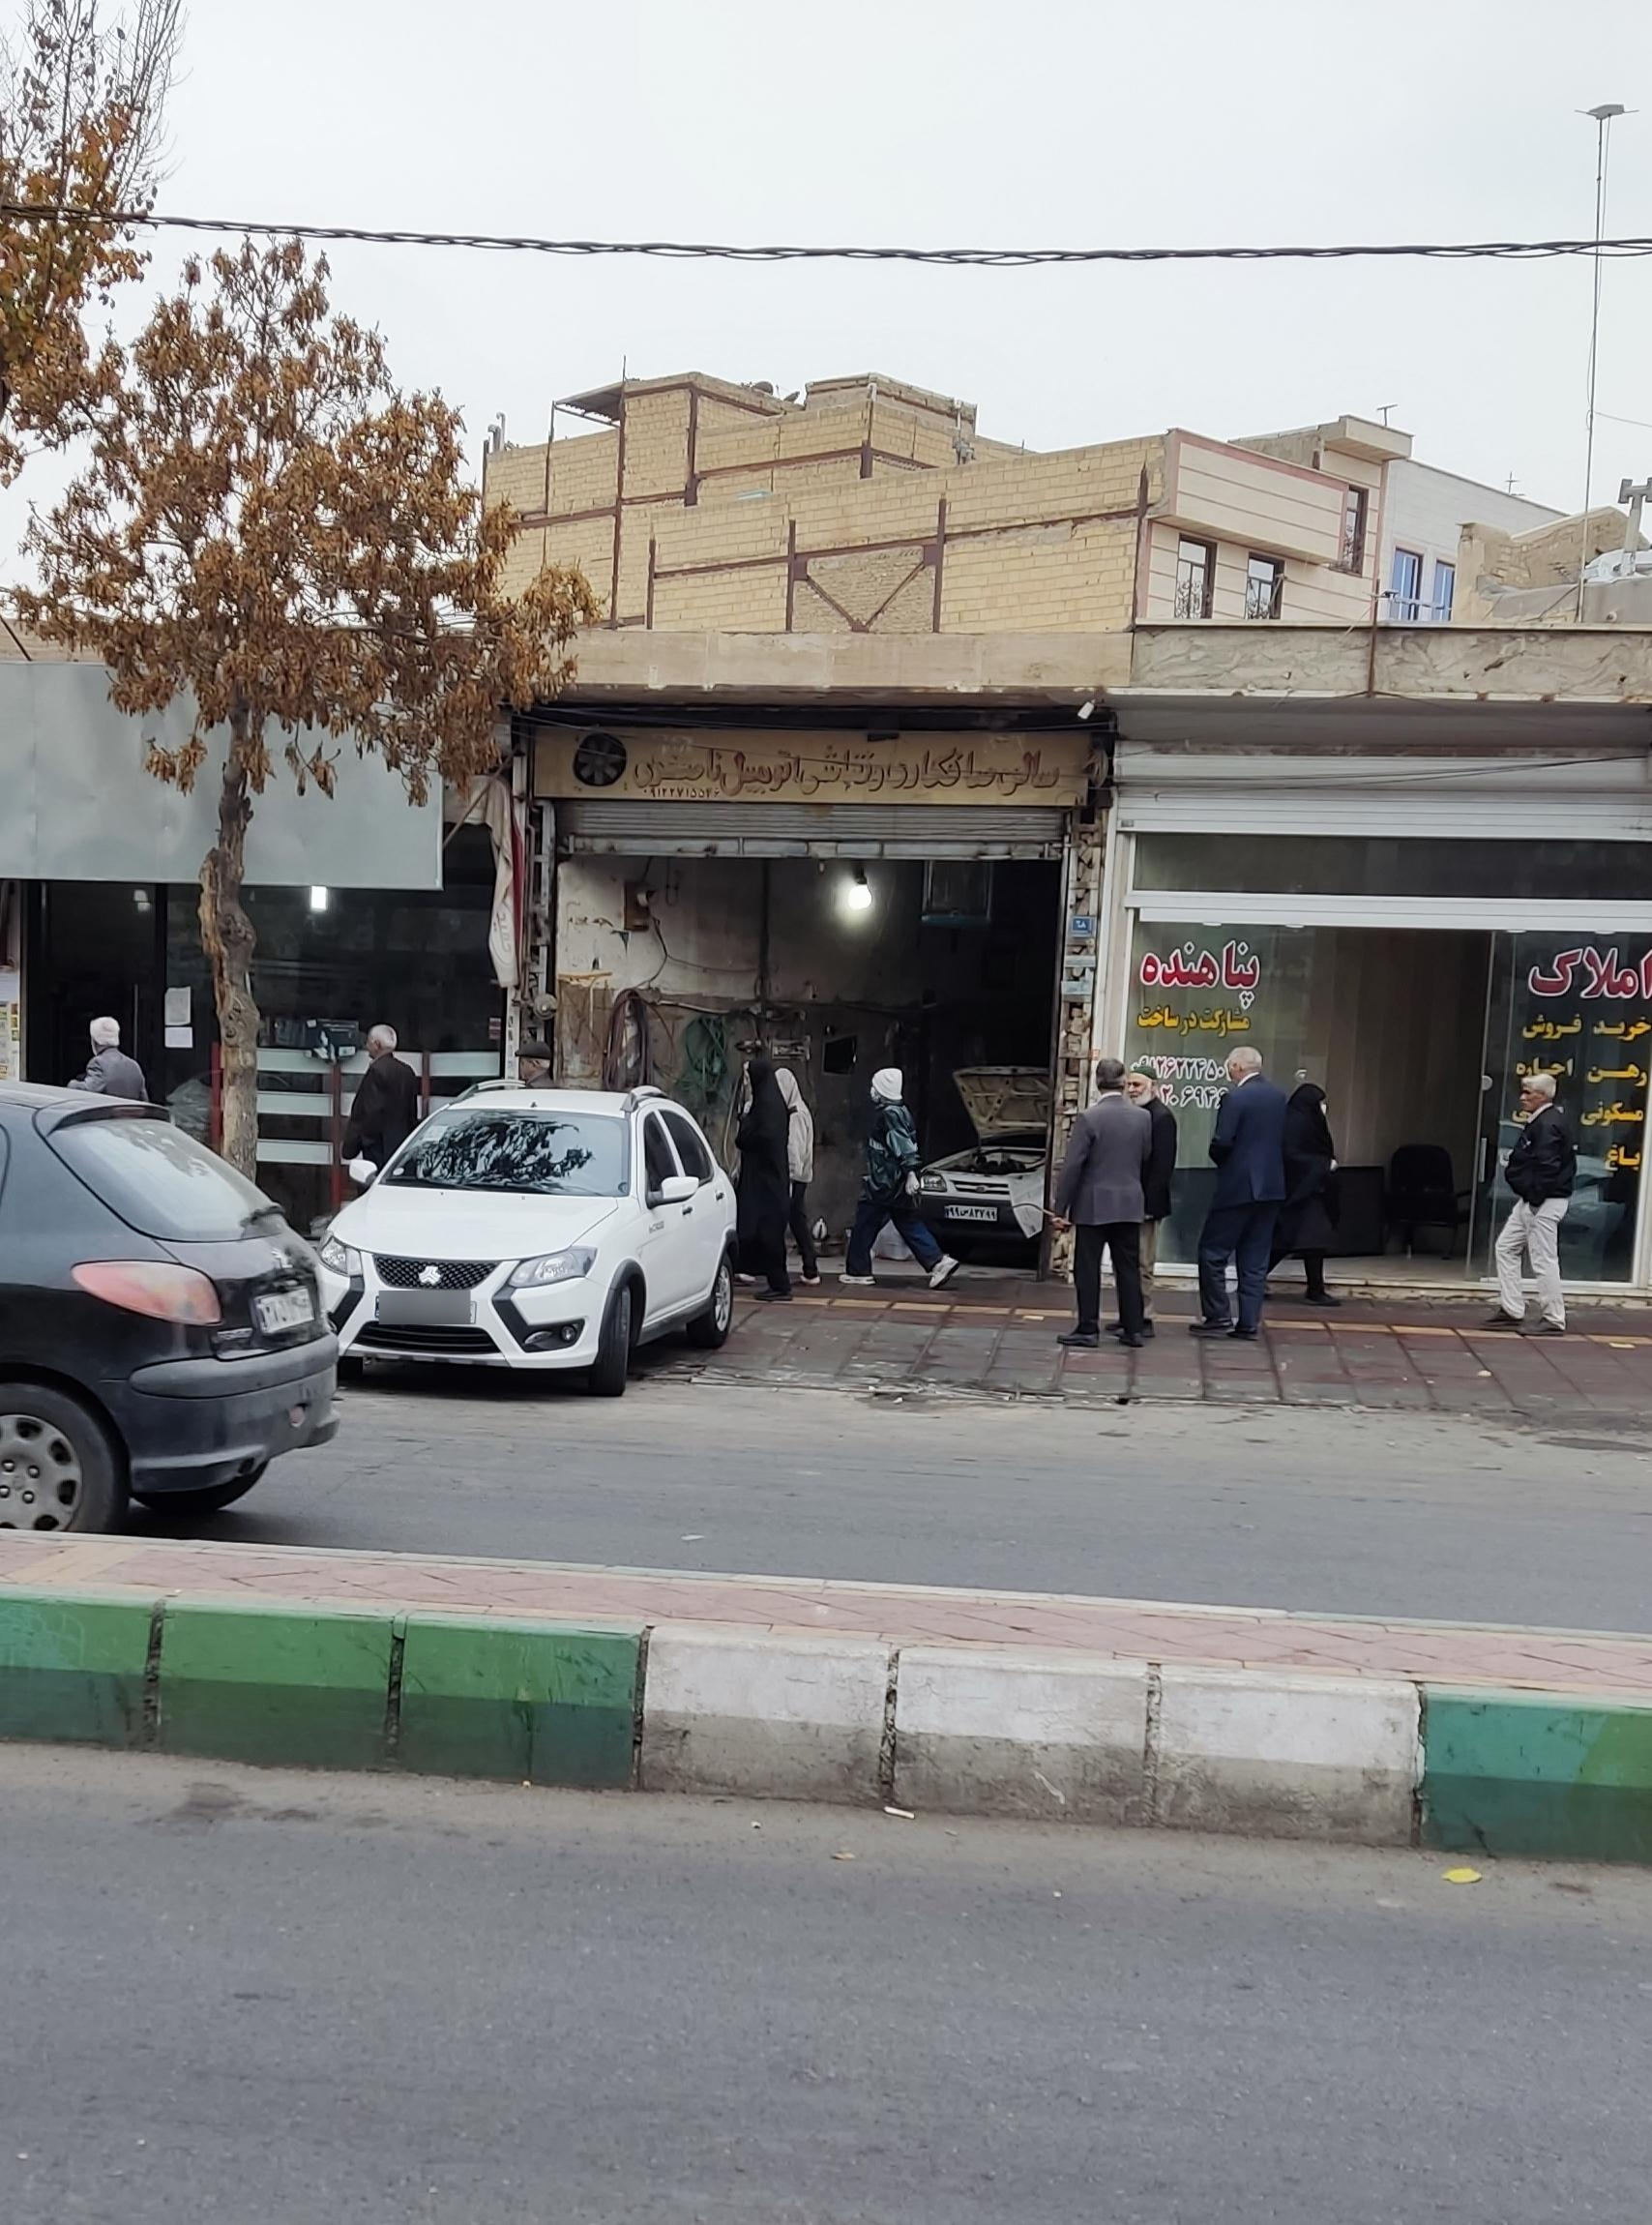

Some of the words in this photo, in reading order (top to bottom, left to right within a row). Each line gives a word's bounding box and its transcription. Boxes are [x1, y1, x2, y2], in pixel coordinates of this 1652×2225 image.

[720, 750, 802, 797] اتومبیل
[1139, 939, 1260, 1009] پناهنده
[1137, 1005, 1179, 1028] ساخت
[1180, 1011, 1196, 1035] در
[1199, 1008, 1251, 1037] مشارکت
[1522, 1014, 1582, 1039] فروش
[1593, 1017, 1652, 1042] خرید
[1587, 1063, 1647, 1087] رهن
[1580, 1101, 1643, 1126] مسکونی
[1605, 1143, 1641, 1172] باغ
